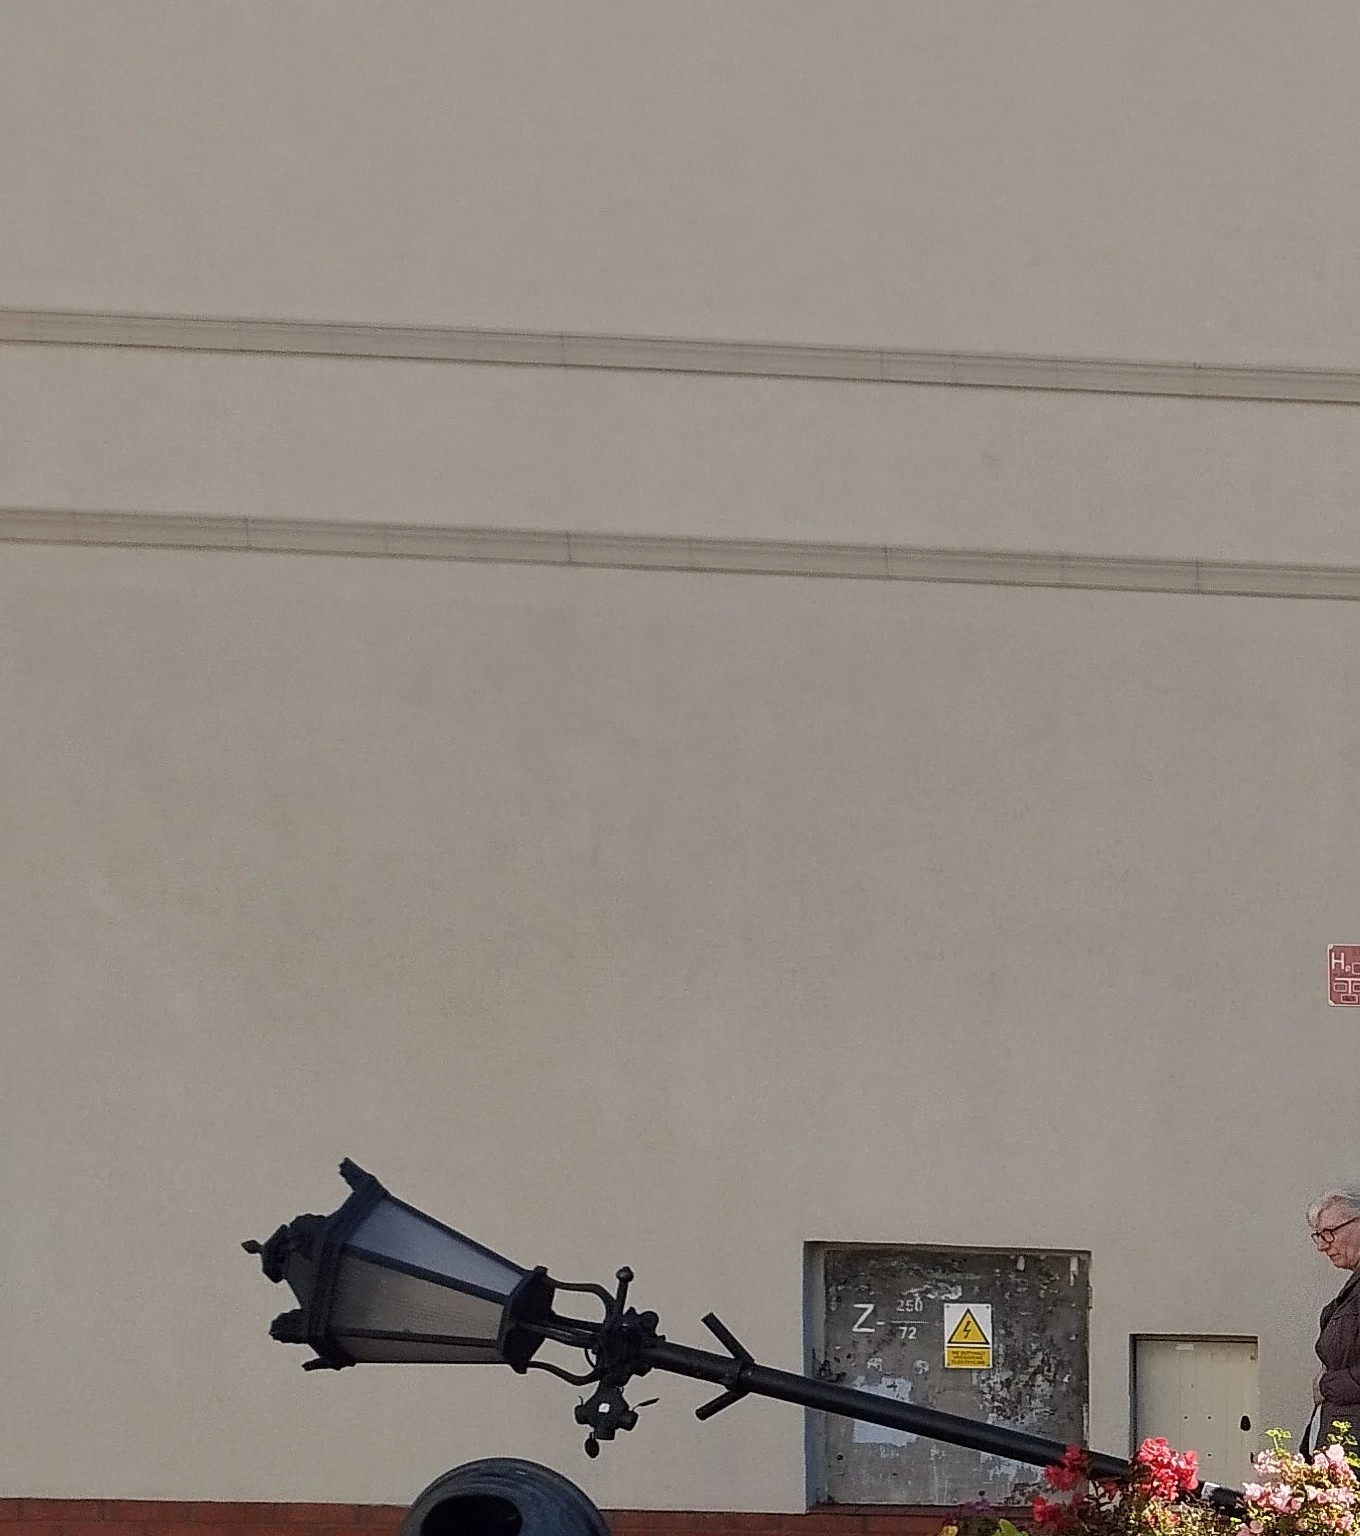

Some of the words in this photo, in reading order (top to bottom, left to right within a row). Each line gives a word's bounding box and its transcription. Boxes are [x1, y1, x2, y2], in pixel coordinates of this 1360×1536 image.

[1331, 952, 1345, 970] H
[896, 1299, 924, 1313] 250
[899, 1326, 917, 1340] 72
